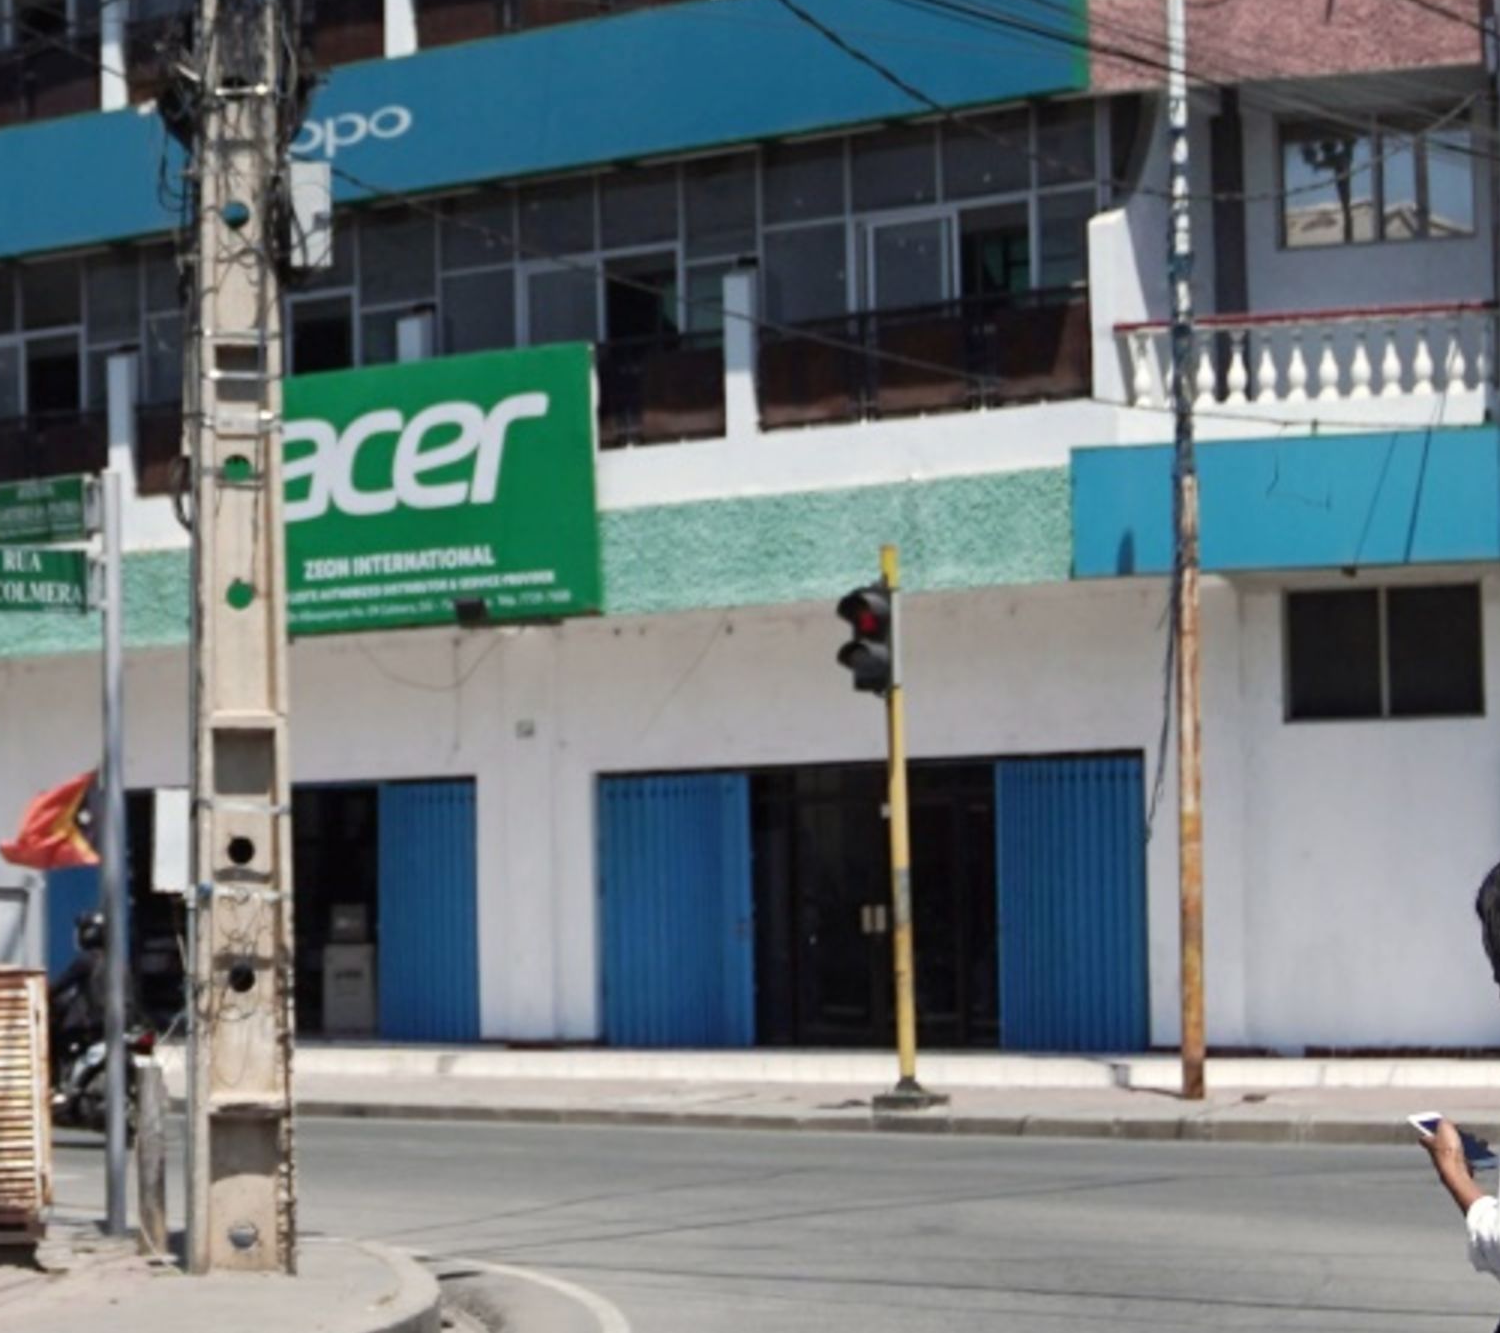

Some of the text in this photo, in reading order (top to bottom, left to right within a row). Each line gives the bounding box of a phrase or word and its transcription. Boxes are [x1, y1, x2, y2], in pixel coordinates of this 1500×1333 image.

[282, 391, 550, 524] acer
[3, 549, 43, 572] RUA
[353, 544, 495, 579] INTERNATIONAL
